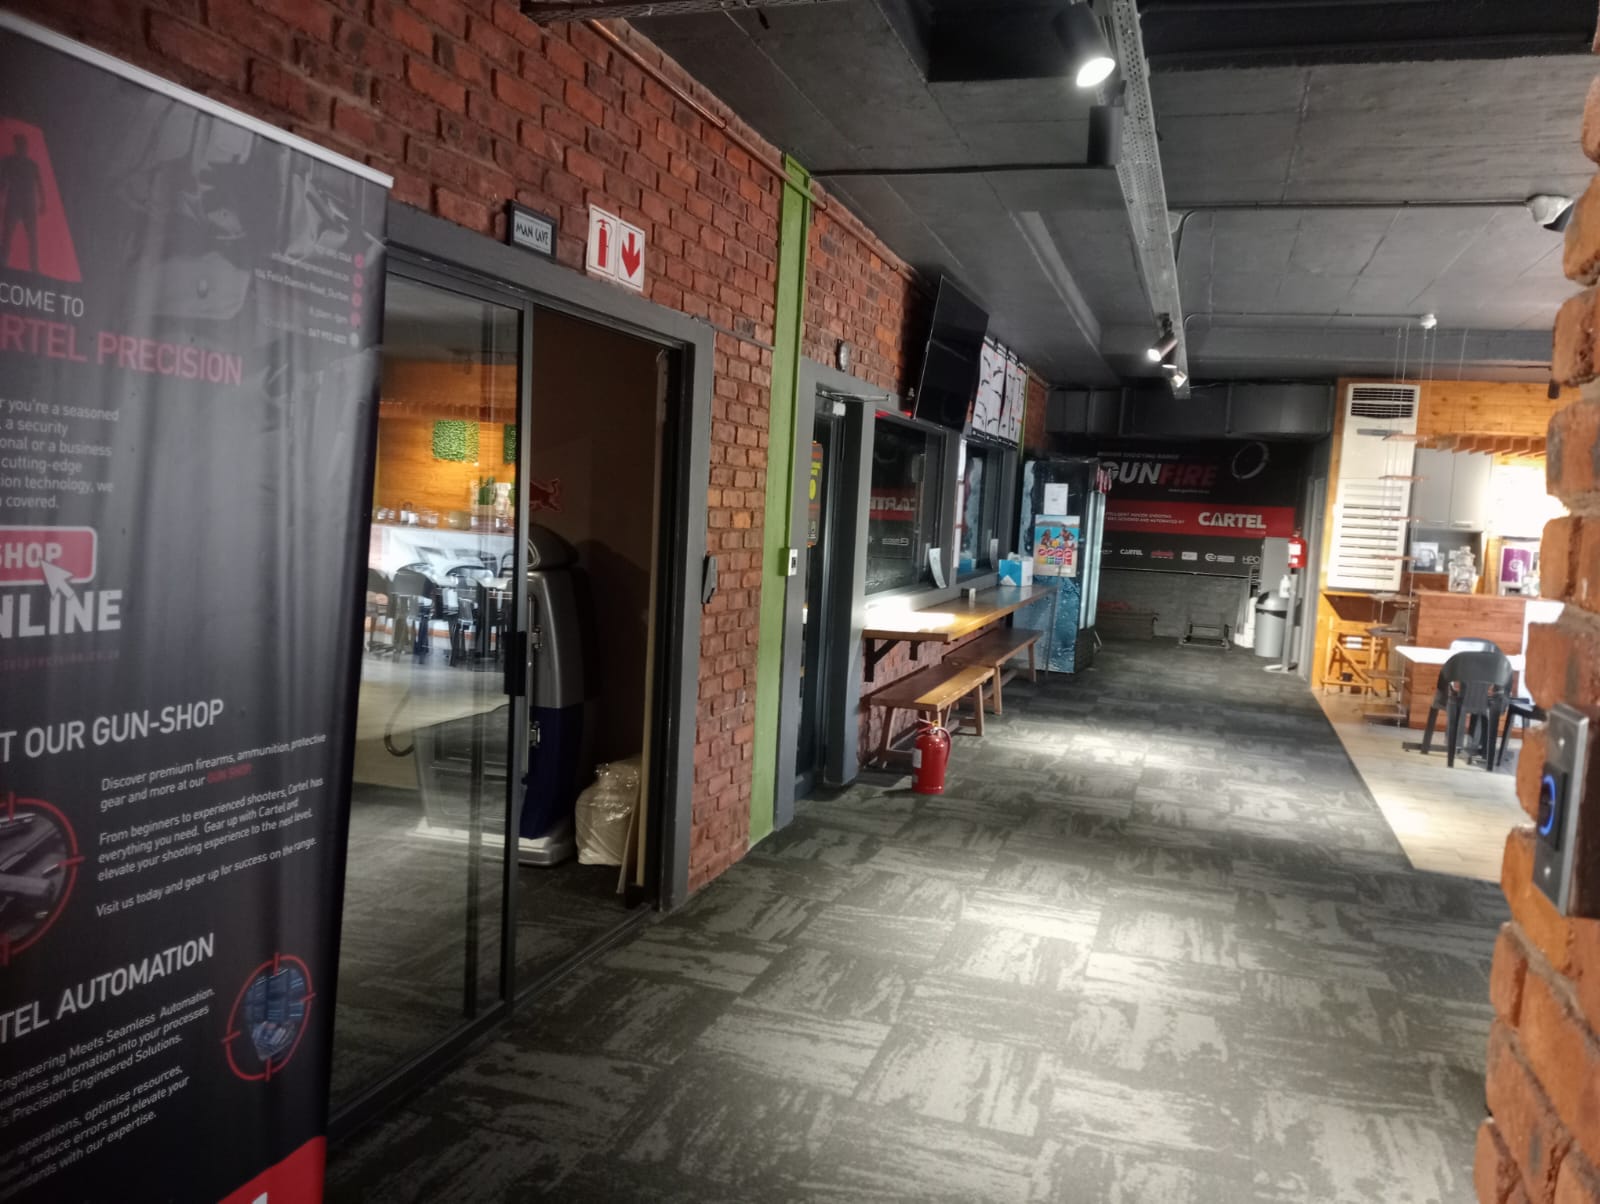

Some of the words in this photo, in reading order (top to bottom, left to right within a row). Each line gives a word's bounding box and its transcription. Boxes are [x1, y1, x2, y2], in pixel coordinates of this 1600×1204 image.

[516, 222, 533, 238] MAN
[534, 229, 549, 246] CAVE
[60, 294, 84, 317] TO
[97, 331, 243, 385] PRECISION
[5, 418, 14, 430] a
[17, 419, 69, 437] security
[8, 398, 49, 414] you're
[51, 404, 60, 416] a
[62, 404, 120, 421] seasoned
[1, 456, 83, 476] cutting-edge
[31, 439, 46, 452] or
[48, 441, 56, 453] a
[59, 440, 113, 457] business
[24, 475, 95, 495] technology,
[96, 480, 115, 493] we
[1101, 461, 1218, 487] GUNFIRE
[5, 495, 60, 509] covered.
[1198, 511, 1267, 529] CARTEL
[1120, 548, 1144, 556] CARTEL
[25, 721, 85, 758] OUR
[92, 699, 224, 746] GUN-SHOP
[101, 773, 147, 791] Discover
[149, 763, 193, 784] premium
[195, 753, 236, 770] firearms,
[291, 734, 326, 751] protective
[99, 830, 128, 845] From
[130, 816, 180, 837] beginners
[181, 812, 192, 823] to
[193, 795, 245, 819] experienced
[288, 779, 309, 795] Cartel
[310, 777, 324, 788] has
[100, 796, 124, 812] gear
[127, 789, 147, 804] and
[150, 785, 175, 797] more
[177, 781, 187, 791] at
[189, 775, 205, 788] our
[97, 862, 136, 881] elevate
[137, 855, 160, 872] your
[161, 843, 202, 862] shooting
[203, 828, 250, 849] experience
[251, 825, 260, 835] to
[261, 820, 277, 832] the
[98, 840, 152, 863] everything
[154, 835, 172, 850] you
[174, 825, 199, 841] need.
[204, 820, 225, 833] Gear
[226, 816, 238, 828] up
[239, 809, 257, 822] with
[258, 802, 286, 817] Cartel
[96, 901, 119, 917] Visit
[121, 897, 134, 909] us
[136, 888, 164, 904] today
[165, 878, 183, 895] and
[184, 873, 206, 891] gear
[207, 869, 219, 880] up
[220, 864, 232, 876] for
[233, 853, 268, 871] success
[269, 850, 281, 860] on
[0, 1001, 50, 1043] TEL
[56, 932, 214, 1020] AUTOMATION
[0, 1053, 67, 1091] Engineering
[69, 1036, 104, 1059] Meets
[105, 1013, 156, 1044] Seamless
[159, 988, 215, 1018] Automation.
[52, 1046, 116, 1085] automation
[117, 1038, 138, 1054] into
[138, 1026, 161, 1047] your
[163, 1005, 209, 1035] processes
[12, 1054, 133, 1122] Precision-Engineered
[135, 1035, 183, 1063] Solutions.
[31, 1138, 71, 1165] reduce
[73, 1119, 109, 1144] errors
[110, 1105, 130, 1125] and
[131, 1088, 167, 1113] elevate
[167, 1076, 190, 1097] your
[84, 1091, 131, 1120] optimise
[59, 1148, 84, 1168] with
[86, 1137, 105, 1154] our
[107, 1111, 156, 1142] expertise.
